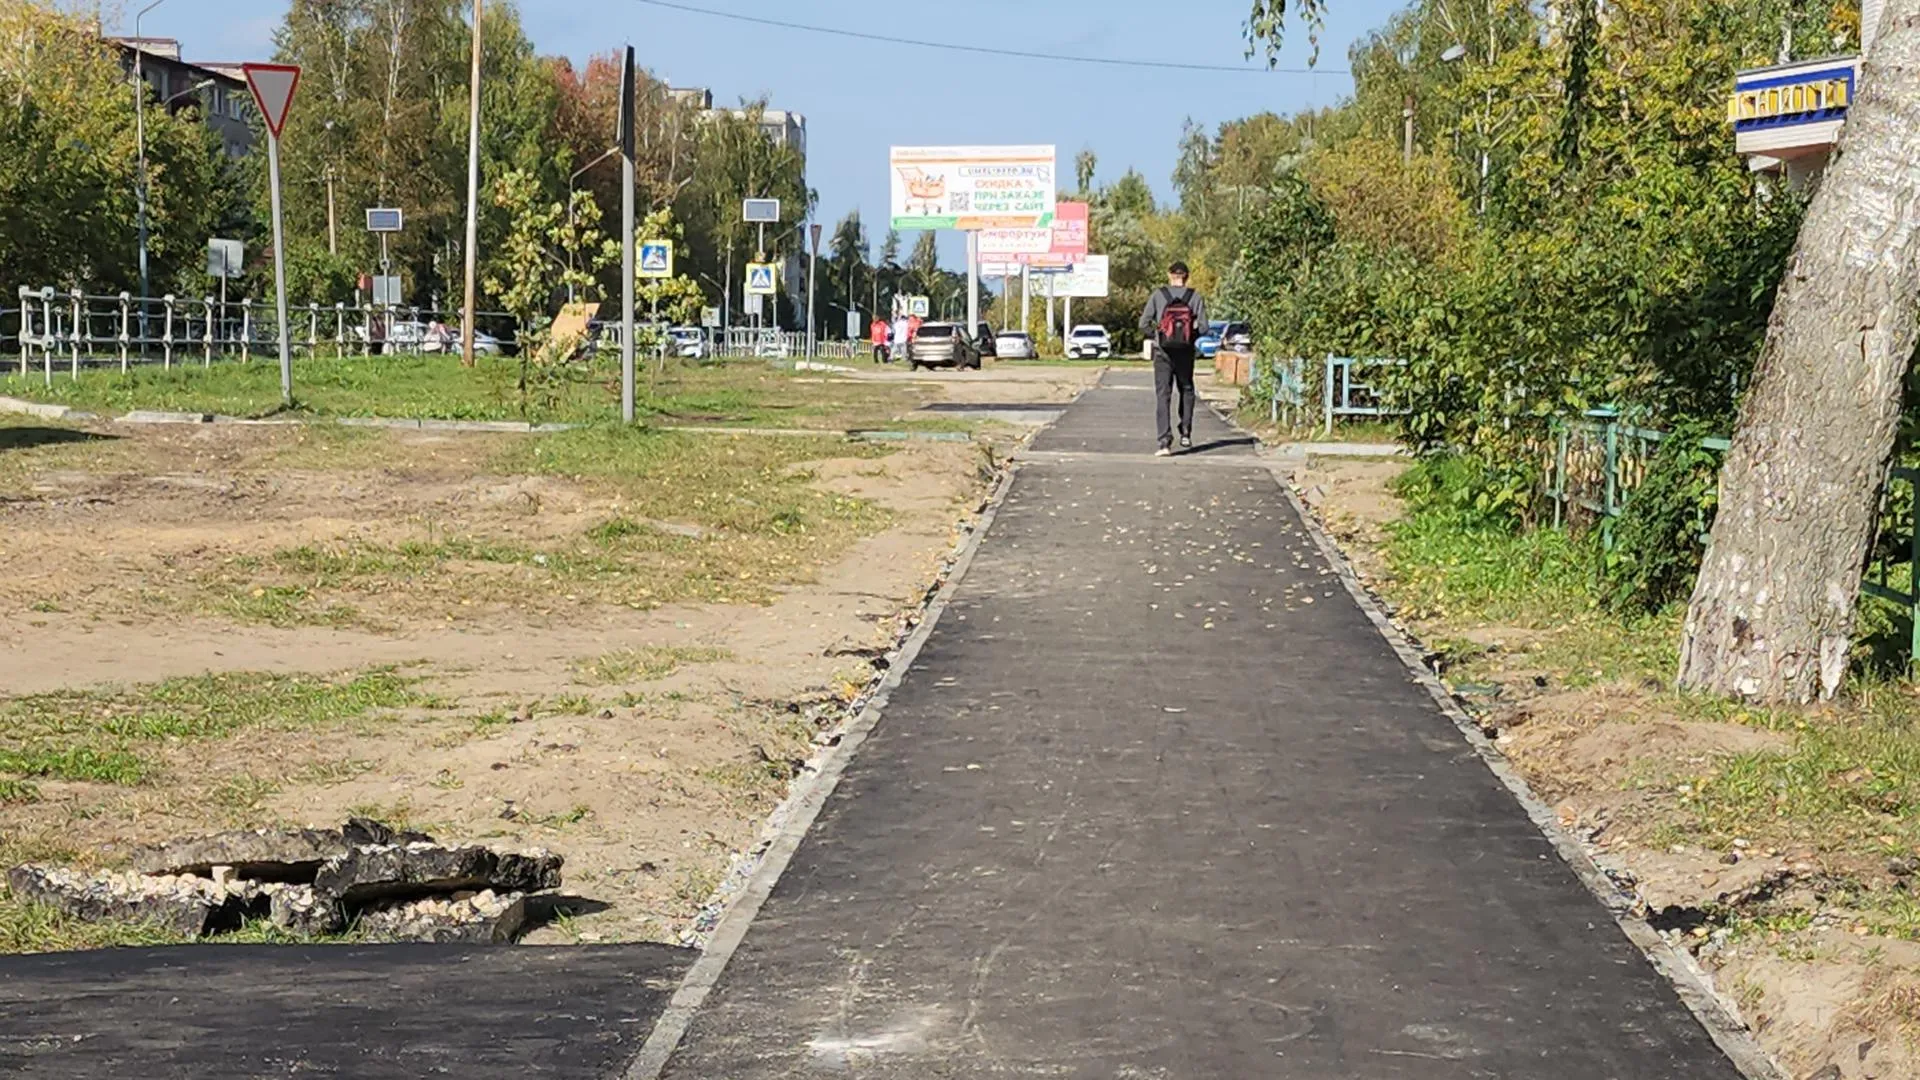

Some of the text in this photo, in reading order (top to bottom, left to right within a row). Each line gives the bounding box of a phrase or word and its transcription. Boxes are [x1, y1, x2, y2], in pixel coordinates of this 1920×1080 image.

[975, 179, 1023, 188] СКИДКА
[974, 190, 997, 200] ПРИ
[974, 202, 1009, 211] ЧЕРЕЗ
